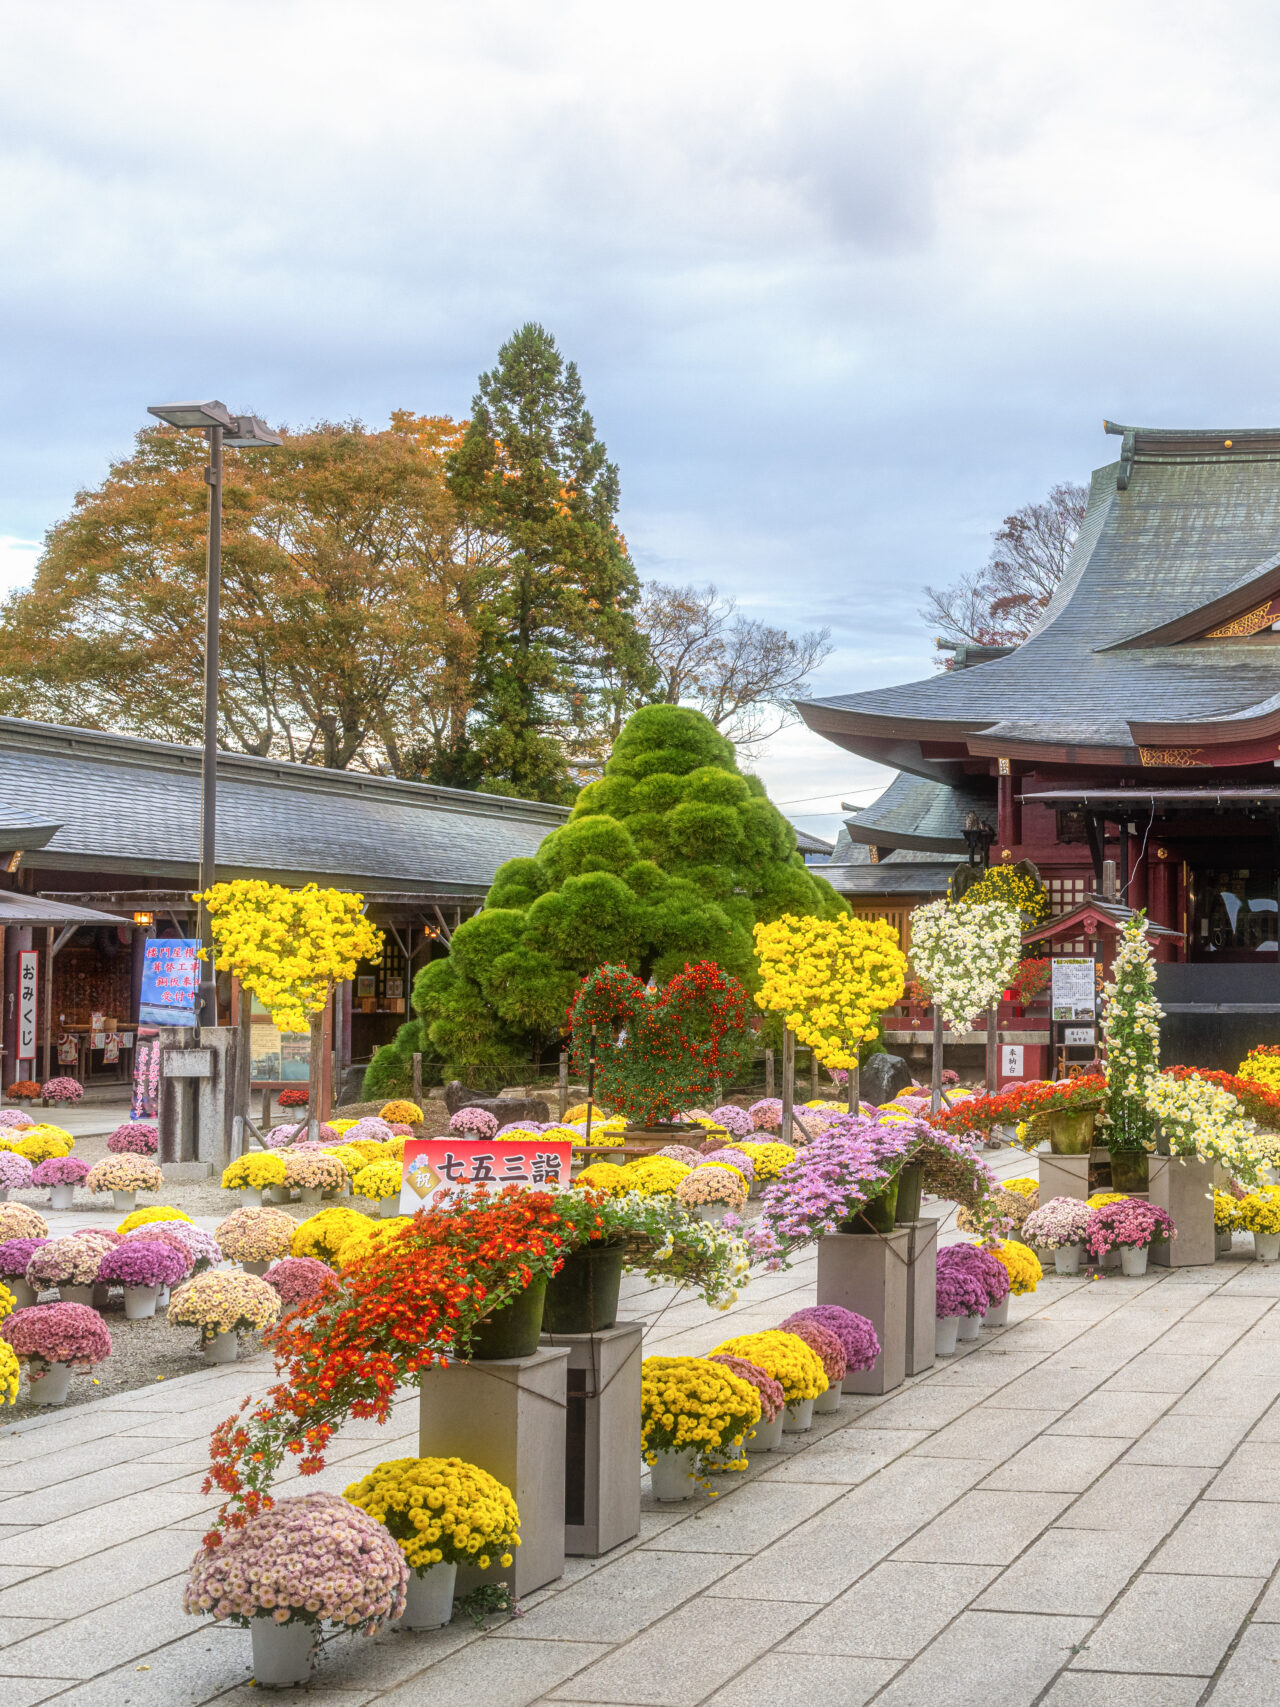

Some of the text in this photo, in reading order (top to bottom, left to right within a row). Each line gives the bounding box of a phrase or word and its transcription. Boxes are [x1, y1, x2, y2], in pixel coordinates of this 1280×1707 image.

[146, 947, 196, 958] 楼門屋根
[152, 961, 200, 974] 葺替工事
[22, 963, 35, 1046] おみくじ
[1008, 1048, 1017, 1074] 奉納台
[135, 1046, 148, 1117] お待ちしております
[415, 1171, 432, 1188] 祝
[436, 1152, 563, 1185] 七五三詣
